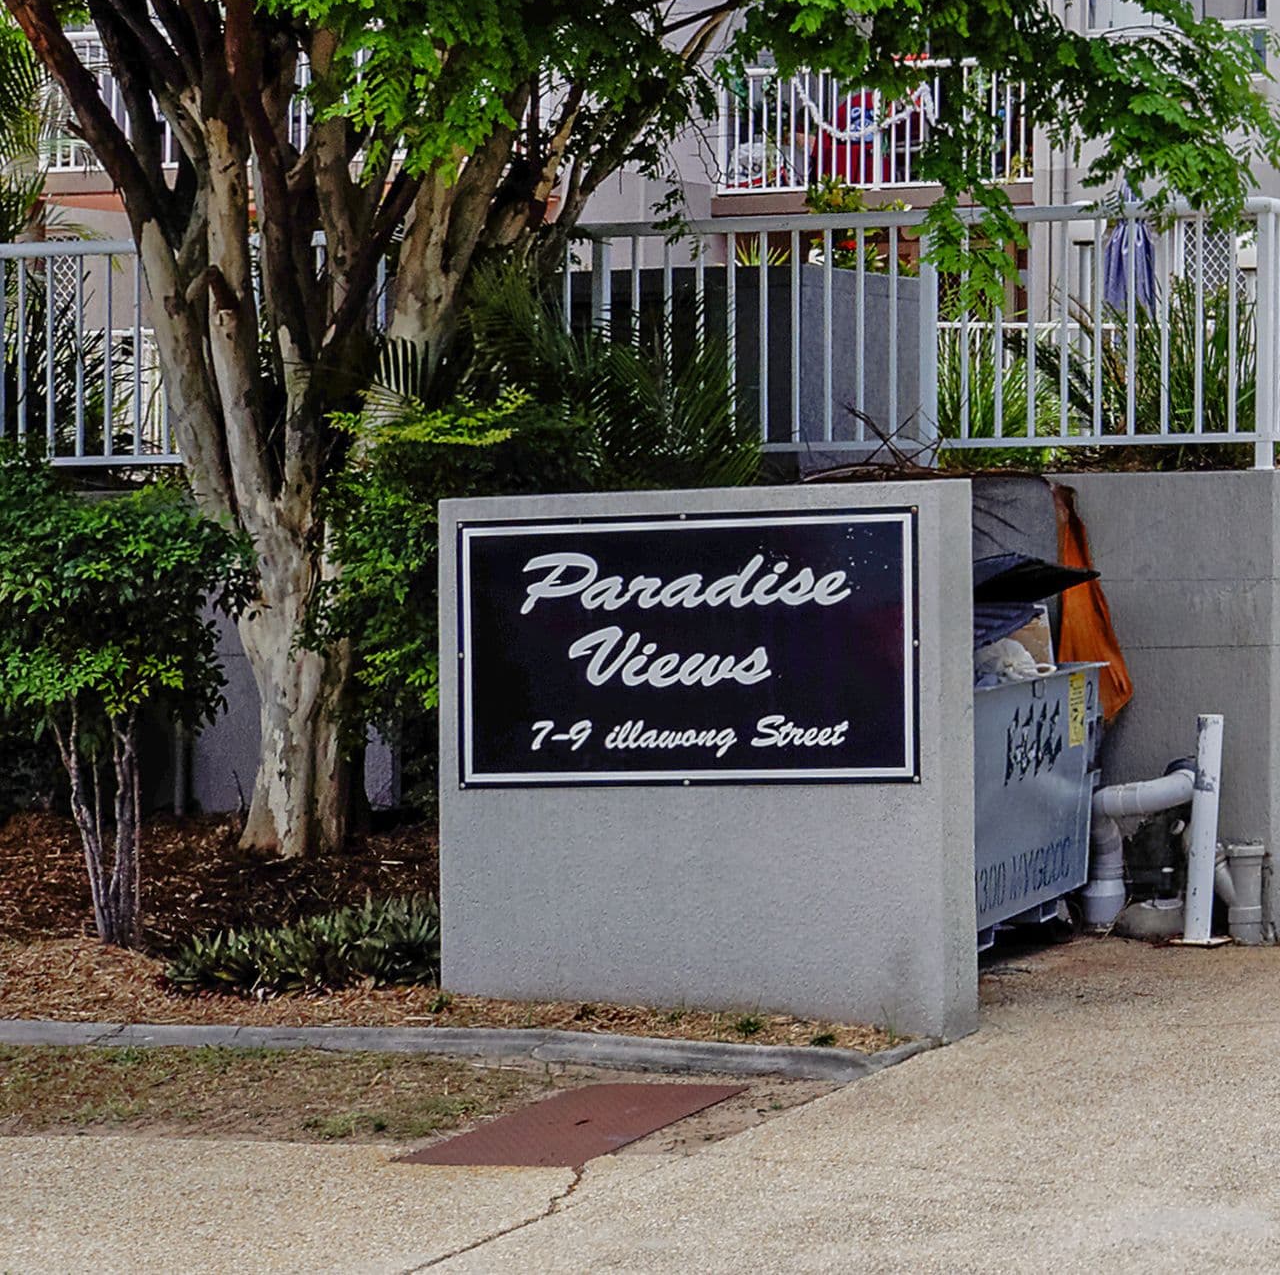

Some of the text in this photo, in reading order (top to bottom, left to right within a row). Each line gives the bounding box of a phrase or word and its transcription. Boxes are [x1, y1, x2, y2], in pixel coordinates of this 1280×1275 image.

[520, 552, 853, 615] Paradise
[567, 625, 773, 688] Views
[530, 714, 849, 758] 7-9 illawong Street
